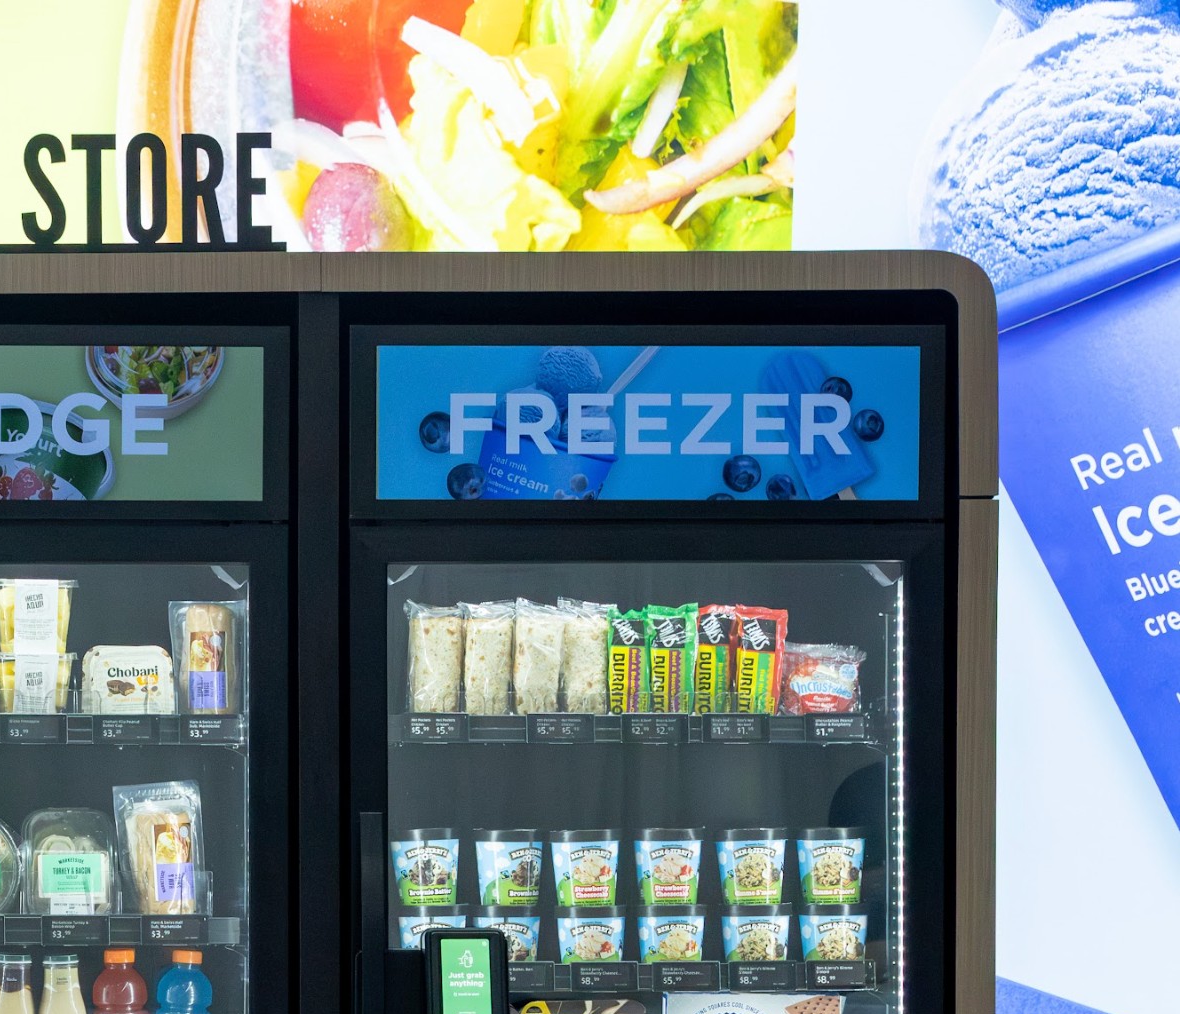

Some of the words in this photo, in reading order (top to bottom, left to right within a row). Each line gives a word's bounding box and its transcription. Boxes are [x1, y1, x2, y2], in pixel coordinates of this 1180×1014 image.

[21, 132, 274, 244] STORE
[449, 393, 852, 455] FREEZER
[487, 462, 504, 478] Ice
[506, 471, 548, 493] cream
[1070, 428, 1162, 490] Real
[1092, 494, 1180, 555] Ice
[1126, 561, 1180, 602] Blue
[107, 666, 158, 677] Chobani
[612, 653, 625, 715] BURRITO
[652, 656, 665, 714] BURRITO
[696, 652, 711, 715] BURRITO
[53, 867, 69, 875] TURKEY
[76, 867, 91, 875] BACON
[449, 980, 483, 988] anything
[466, 972, 484, 980] grab
[709, 1002, 730, 1012] SQUARES
